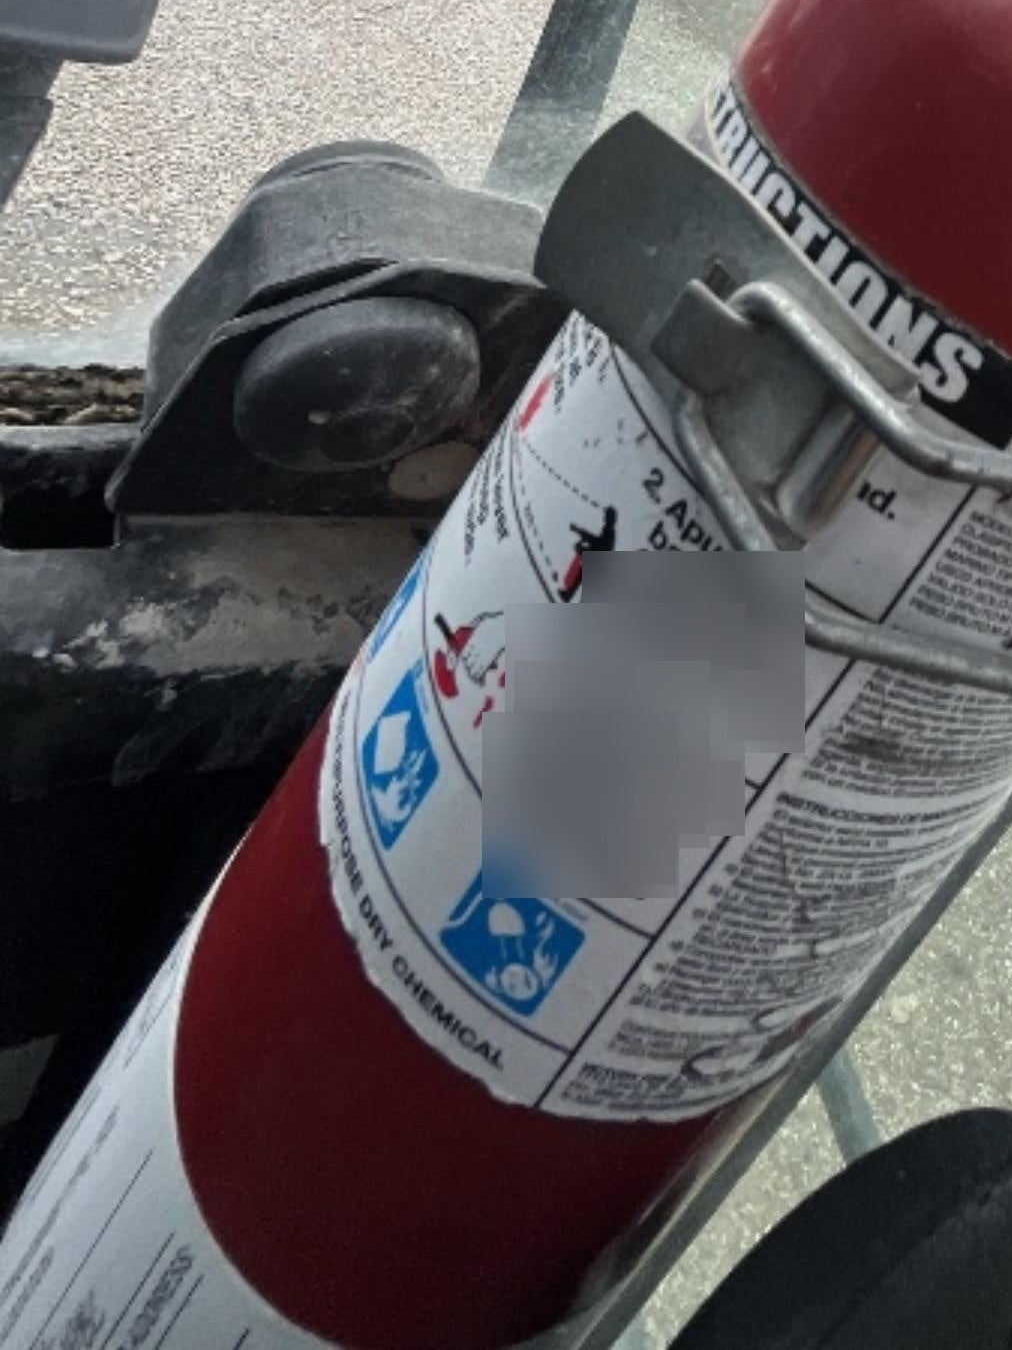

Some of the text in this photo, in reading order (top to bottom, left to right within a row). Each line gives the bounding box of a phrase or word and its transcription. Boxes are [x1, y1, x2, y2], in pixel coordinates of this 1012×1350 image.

[711, 88, 985, 404] TRUCTIONS
[642, 466, 666, 505] 2.
[664, 499, 724, 551] Apu
[359, 895, 394, 953] DRY
[391, 954, 505, 1071] CHEMICAL
